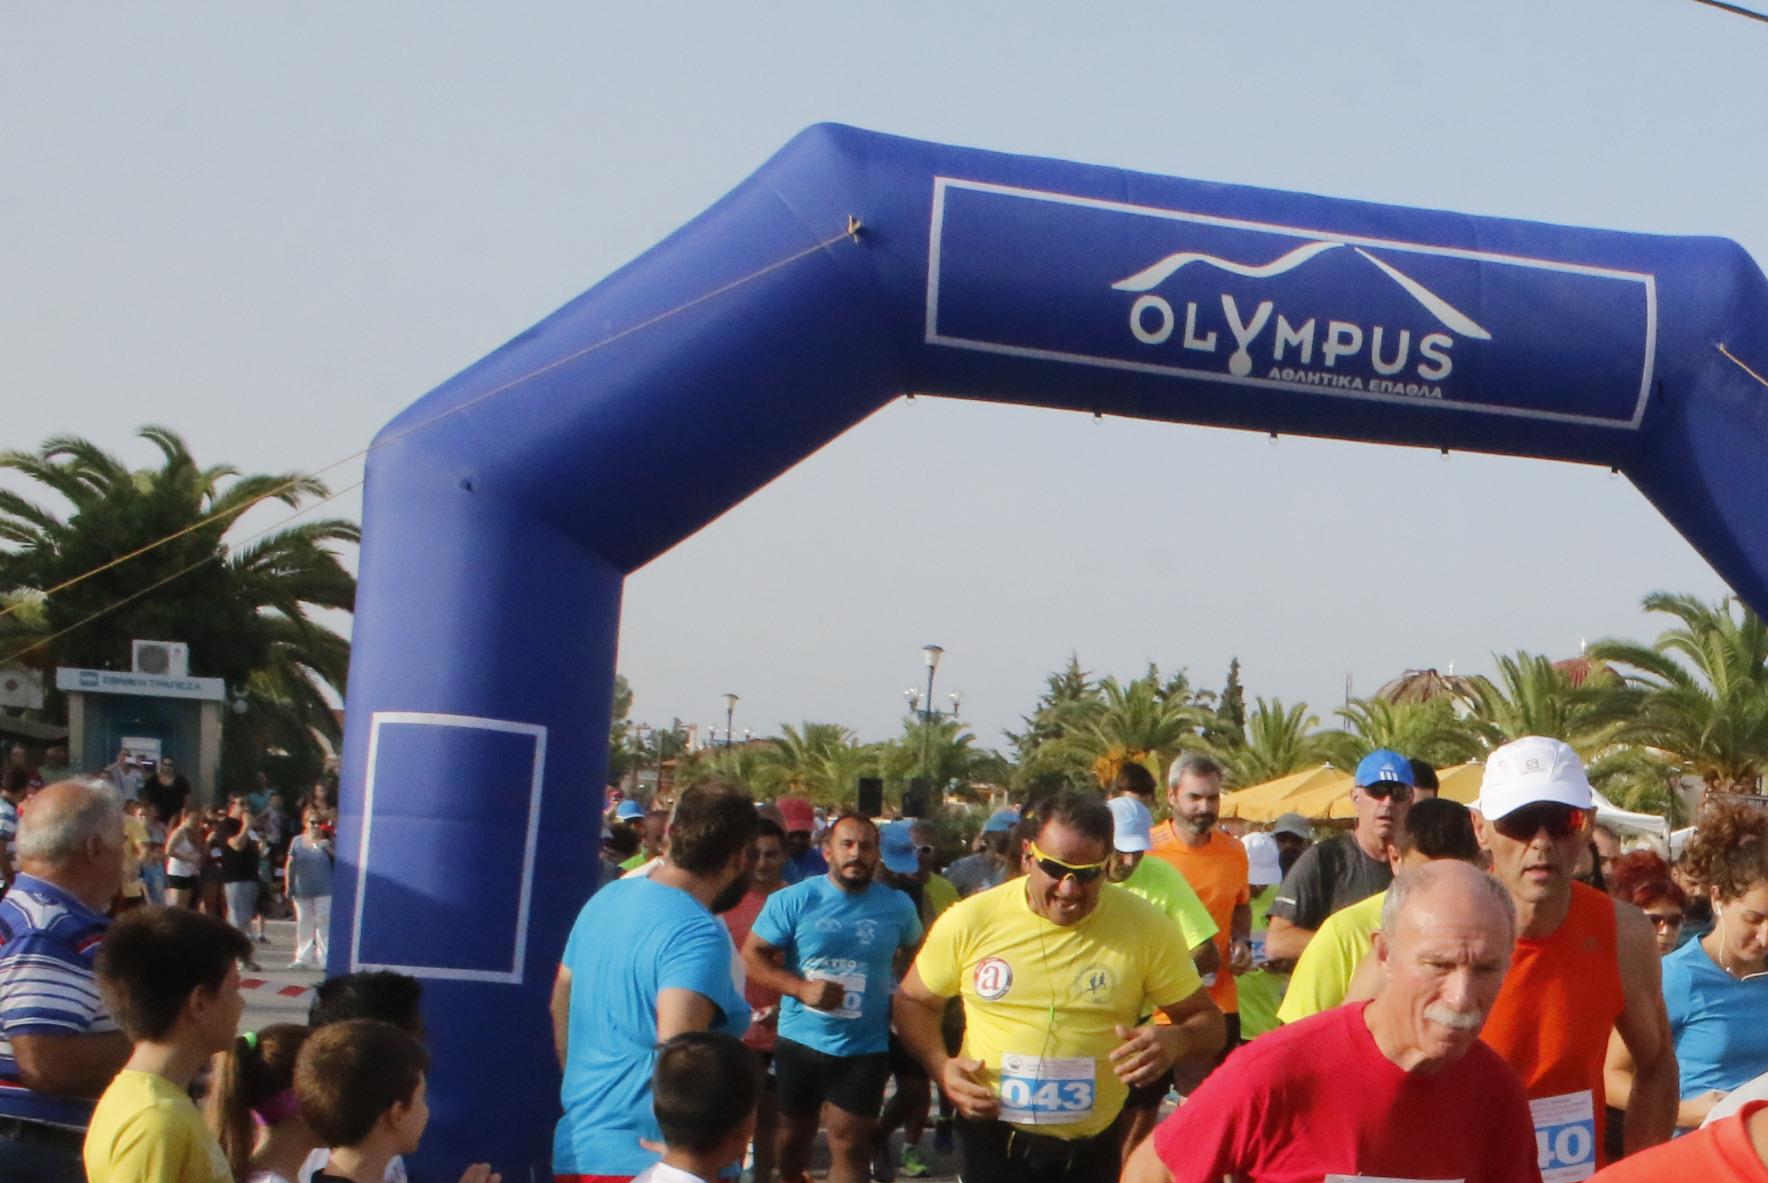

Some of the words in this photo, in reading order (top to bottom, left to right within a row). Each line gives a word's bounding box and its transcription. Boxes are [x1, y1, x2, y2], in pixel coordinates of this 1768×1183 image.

[1130, 294, 1454, 381] OLYMPUS
[1268, 366, 1364, 391] ΑΘΛΗΤΙΚΑ
[1368, 377, 1443, 400] ΕΠΑΘΛΑ
[1001, 1079, 1092, 1110] 043
[1535, 1126, 1592, 1168] 40
